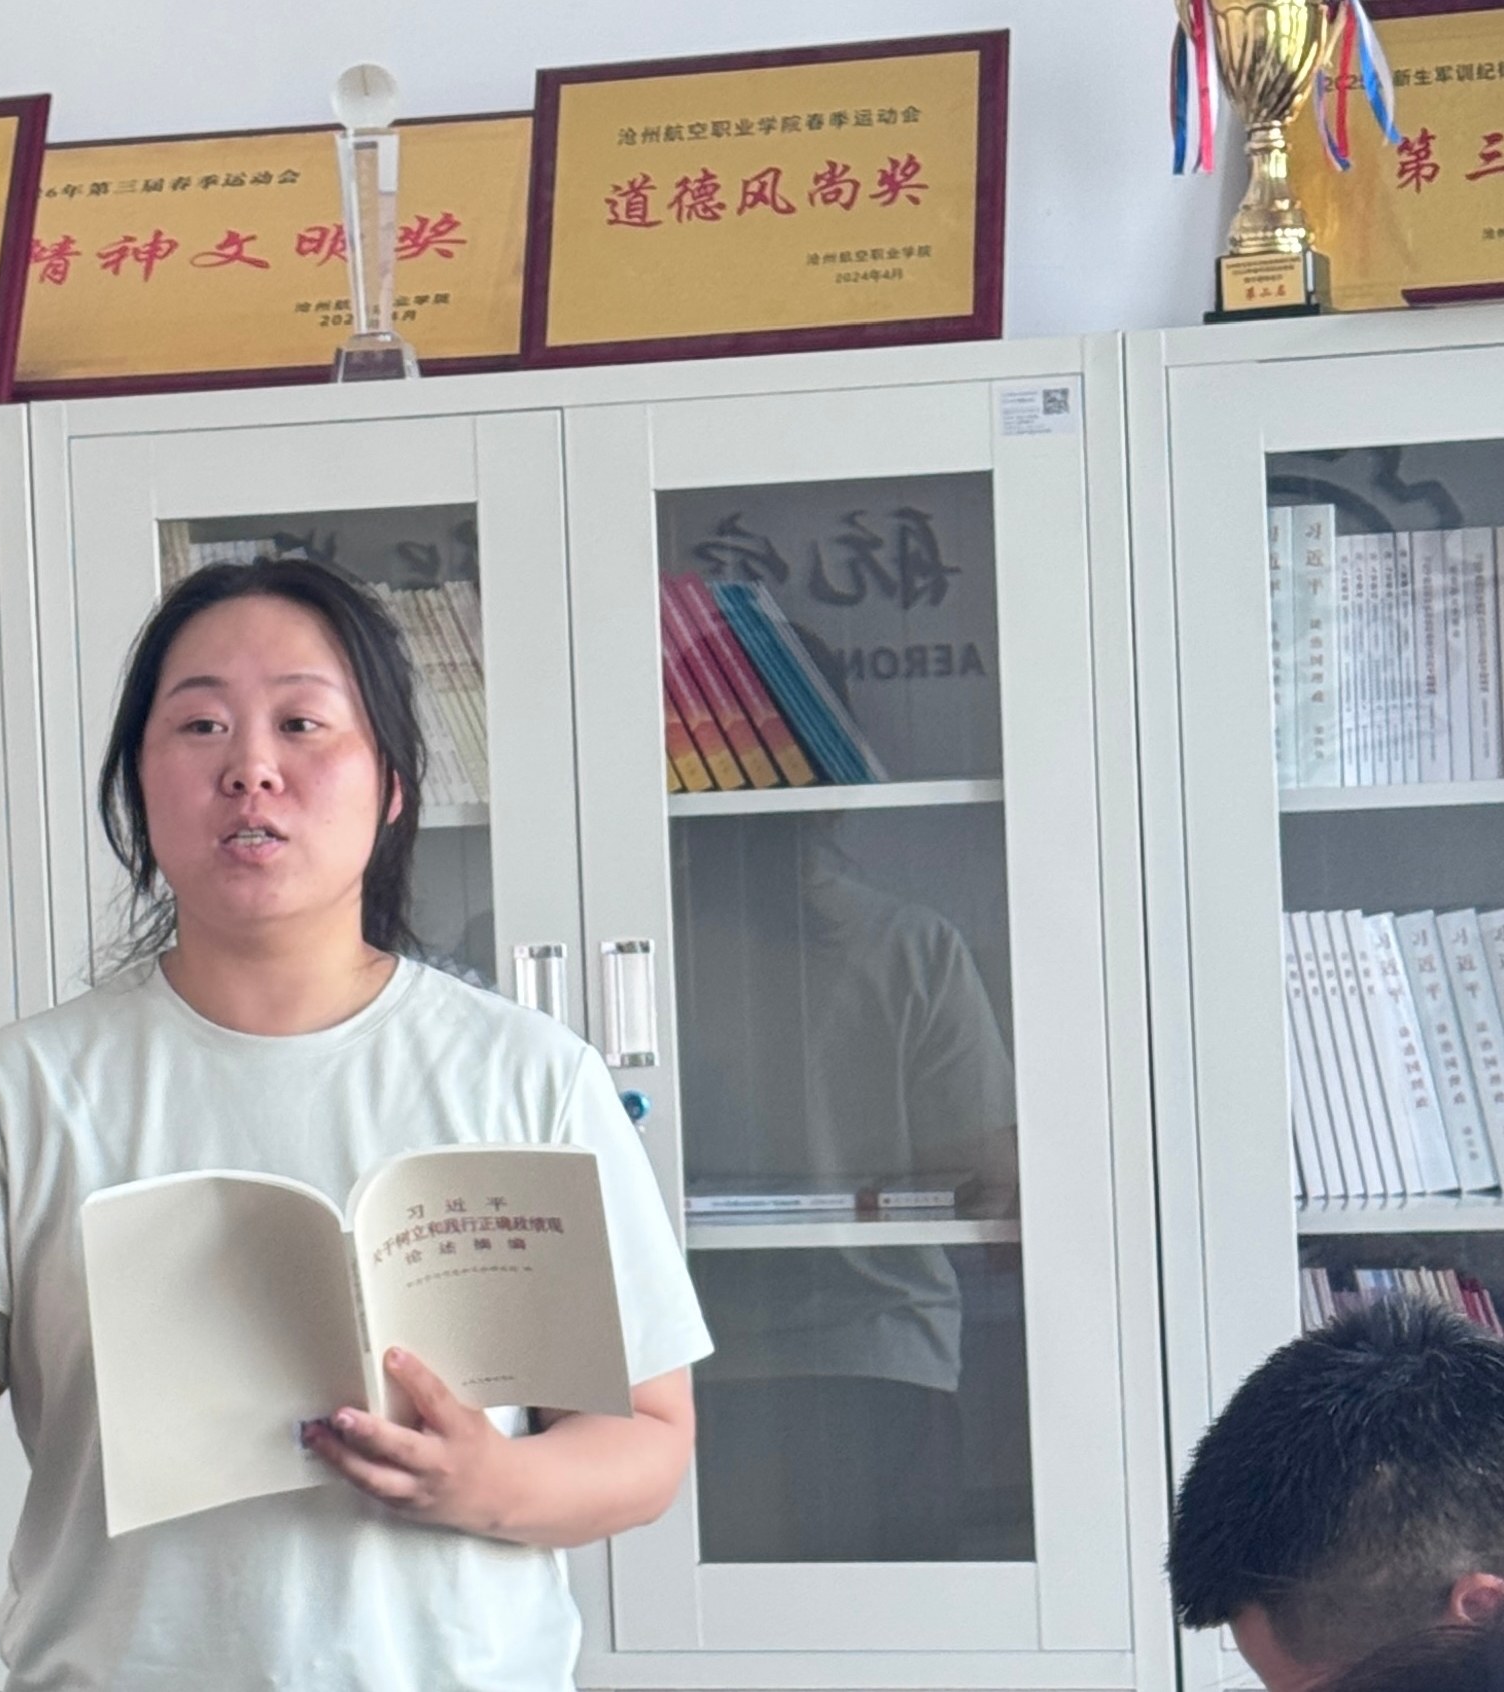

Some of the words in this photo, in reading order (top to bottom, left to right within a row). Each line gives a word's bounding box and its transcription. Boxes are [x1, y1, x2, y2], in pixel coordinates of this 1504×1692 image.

[617, 106, 921, 146] 沧州航空职业学院春季运动会
[34, 168, 300, 198] 6年第三届春季运动会
[604, 153, 929, 228] 道德风尚奖
[406, 1196, 507, 1220] 习近平
